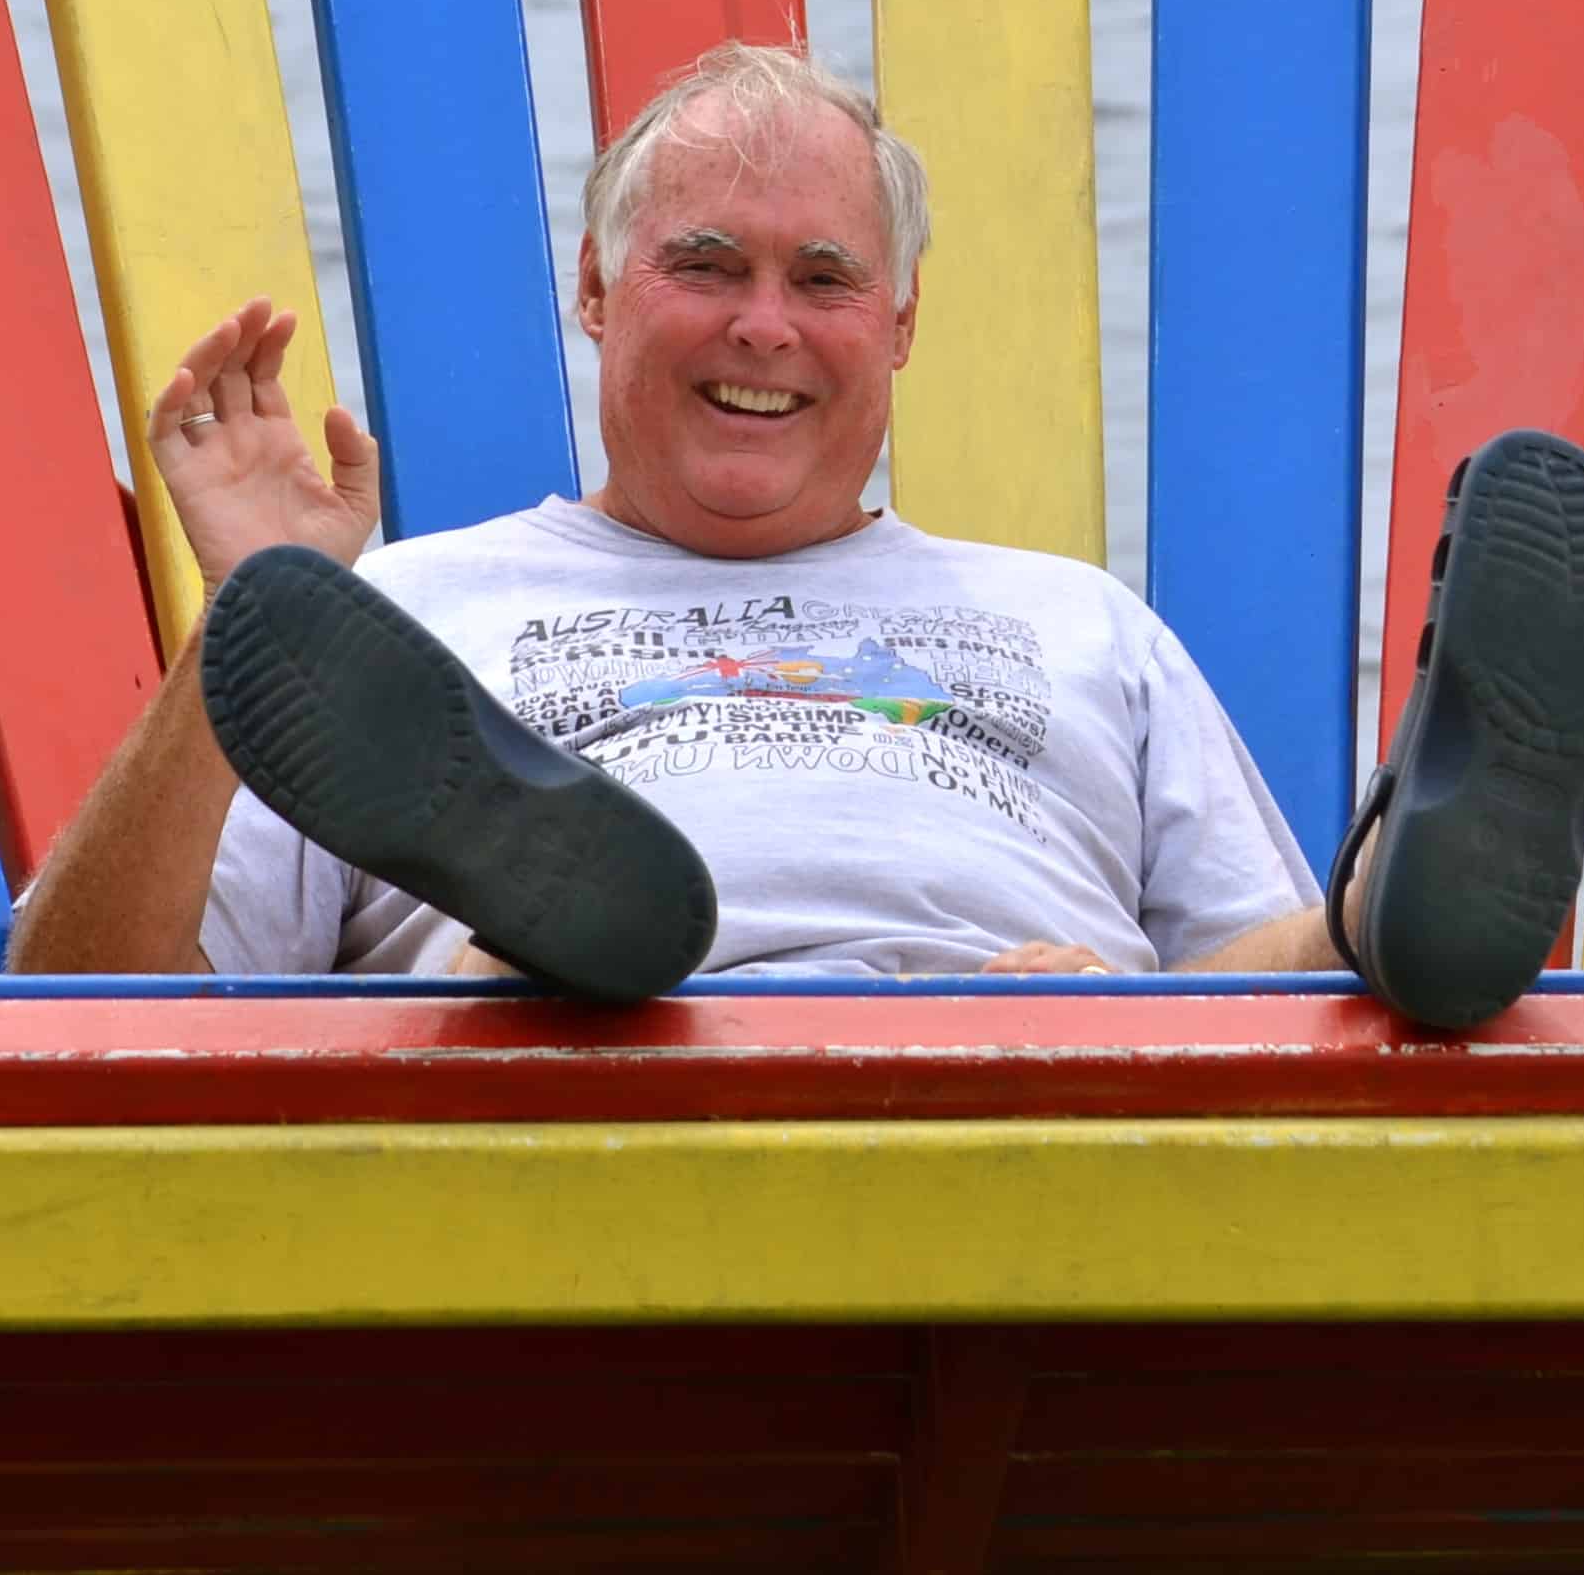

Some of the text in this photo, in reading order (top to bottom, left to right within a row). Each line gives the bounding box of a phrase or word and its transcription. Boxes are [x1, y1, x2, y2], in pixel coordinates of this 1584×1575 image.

[512, 595, 795, 648] AUSTRALIA
[884, 636, 949, 650] SHE'S
[569, 678, 627, 694] MUCH
[517, 687, 616, 717] CAN A
[524, 696, 616, 724] KOALA
[728, 709, 866, 725] SHRIMP
[712, 722, 864, 736] ON THE
[724, 732, 842, 745] BARBY
[948, 709, 1030, 771] Opera
